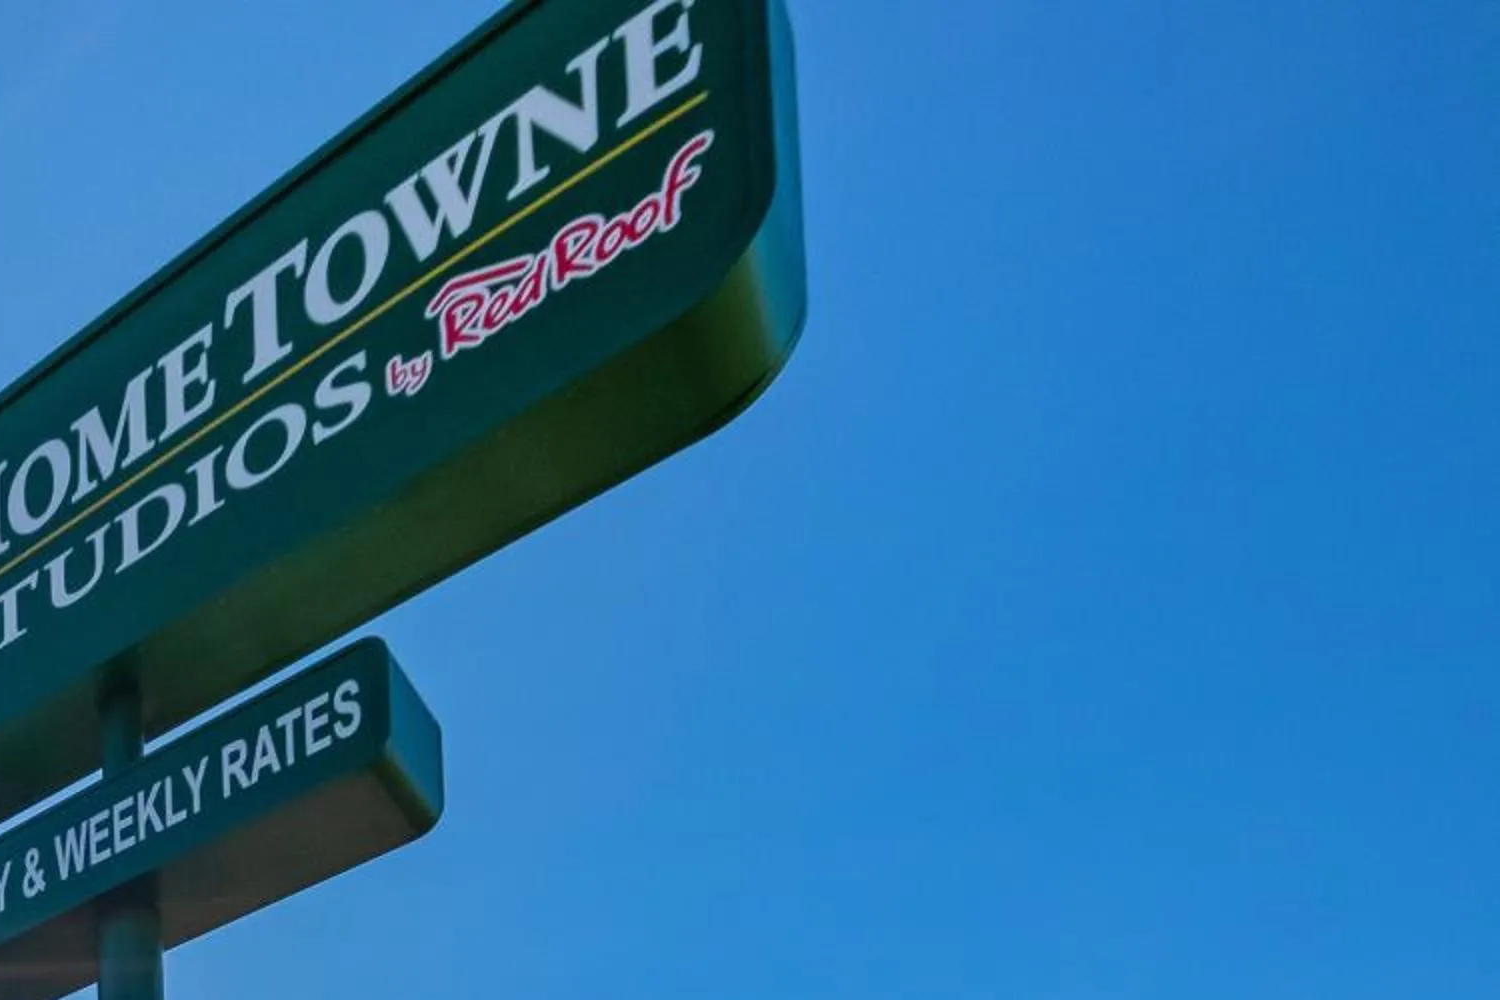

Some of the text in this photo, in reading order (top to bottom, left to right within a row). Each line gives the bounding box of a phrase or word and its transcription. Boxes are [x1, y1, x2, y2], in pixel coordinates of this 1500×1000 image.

[386, 350, 433, 397] by
[22, 846, 47, 899] &
[54, 755, 210, 881] WEEKLY
[221, 678, 362, 799] RATES
